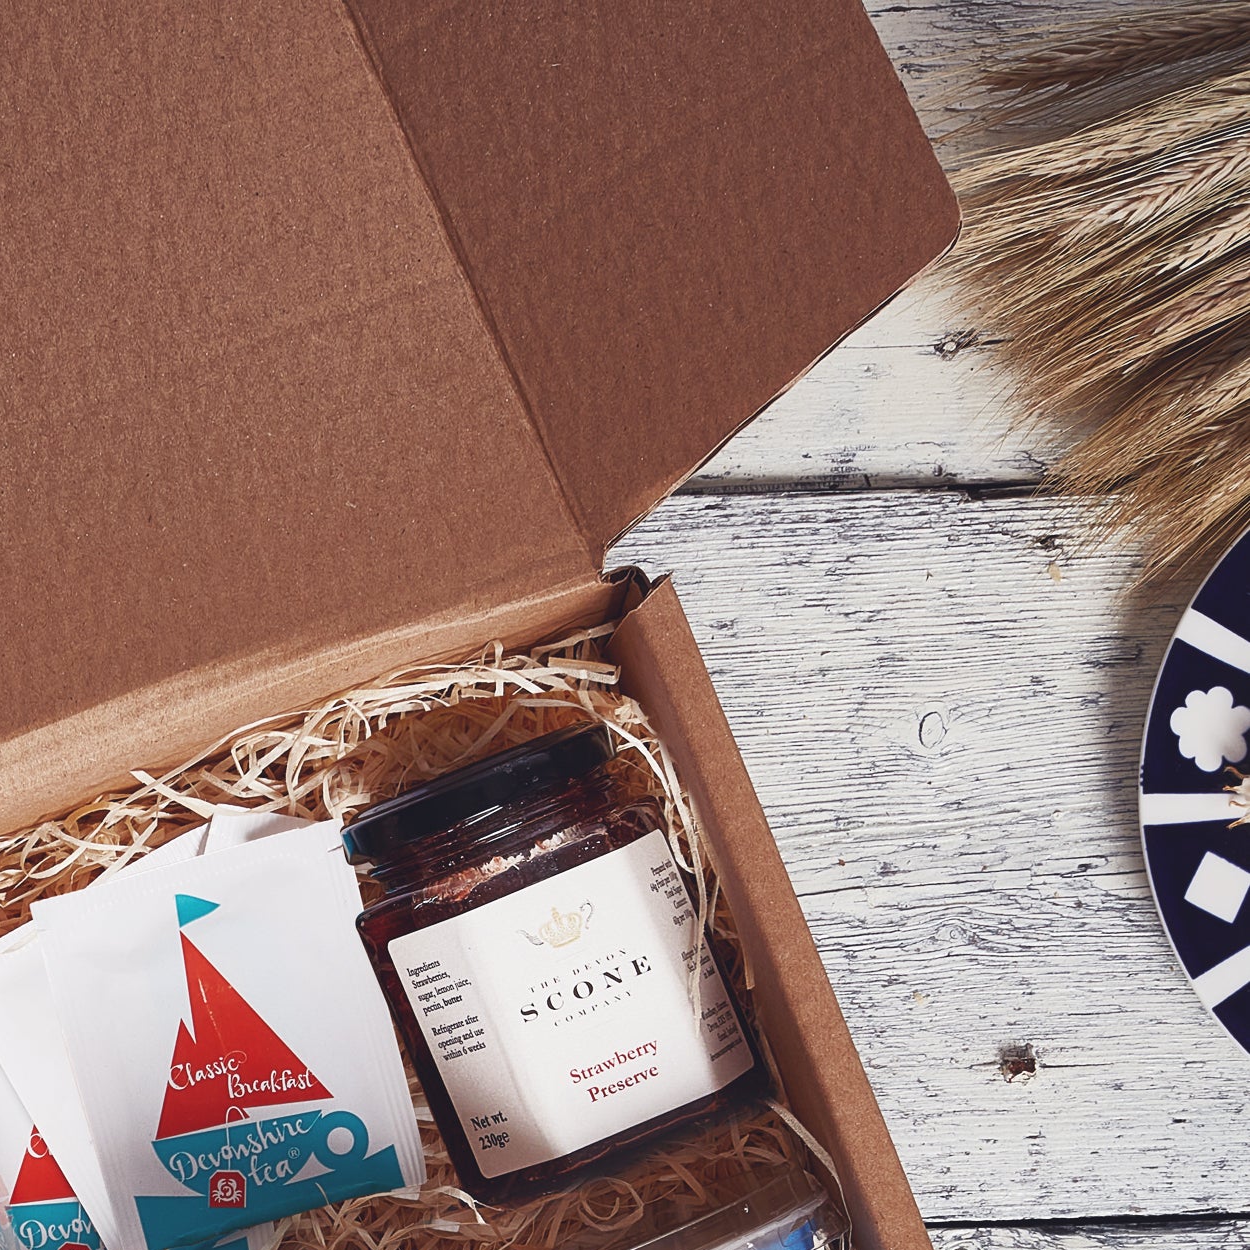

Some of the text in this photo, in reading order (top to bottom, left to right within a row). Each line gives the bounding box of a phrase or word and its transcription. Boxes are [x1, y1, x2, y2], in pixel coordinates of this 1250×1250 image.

[407, 960, 440, 977] Ingredients
[412, 971, 451, 989] Strawberries,
[529, 947, 627, 993] THE DEVON
[418, 978, 472, 1003] sugar, lemon juice,
[520, 955, 652, 1023] SCONE
[422, 994, 463, 1016] pectin, butter
[554, 989, 632, 1027] COMPANY
[431, 1015, 479, 1036] Refrigerate after
[438, 1027, 485, 1051] opening and use
[443, 1041, 486, 1061] within 6 weeks
[569, 1040, 657, 1084] Strawberry
[168, 1050, 247, 1090] Classic
[226, 1067, 319, 1098] Breakfast
[586, 1066, 659, 1102] Preserve
[470, 1110, 508, 1131] Net wt.
[169, 1110, 323, 1184] Devonshire
